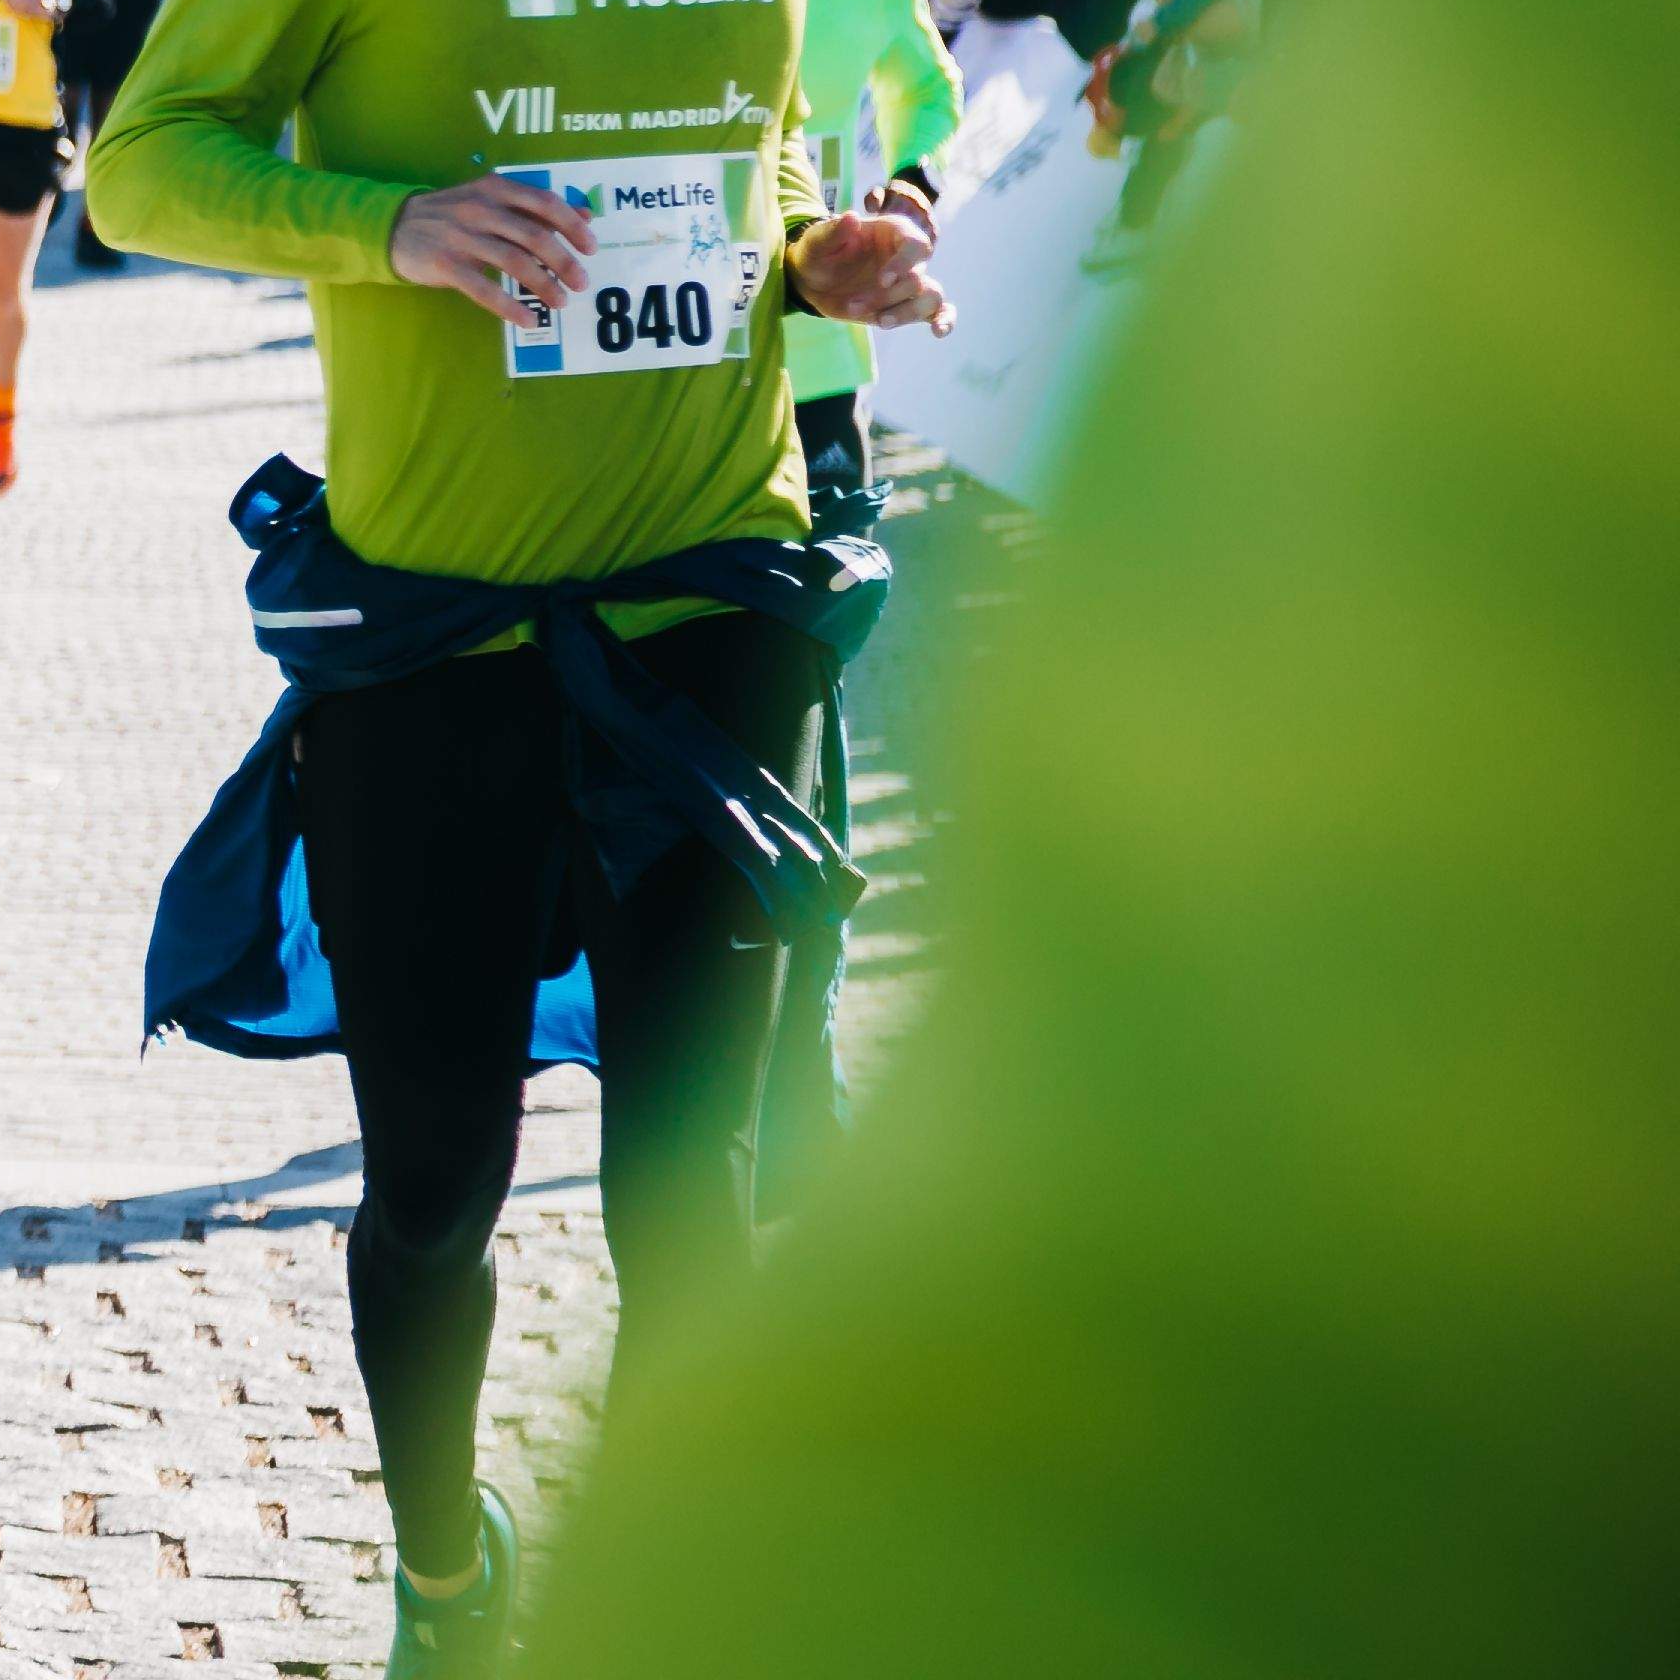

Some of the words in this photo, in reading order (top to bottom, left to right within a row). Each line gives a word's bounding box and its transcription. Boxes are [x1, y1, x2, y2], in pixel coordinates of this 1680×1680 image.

[474, 86, 556, 135] VIII
[561, 113, 622, 131] 15KM
[615, 183, 715, 210] MetLife
[596, 281, 712, 353] 840
